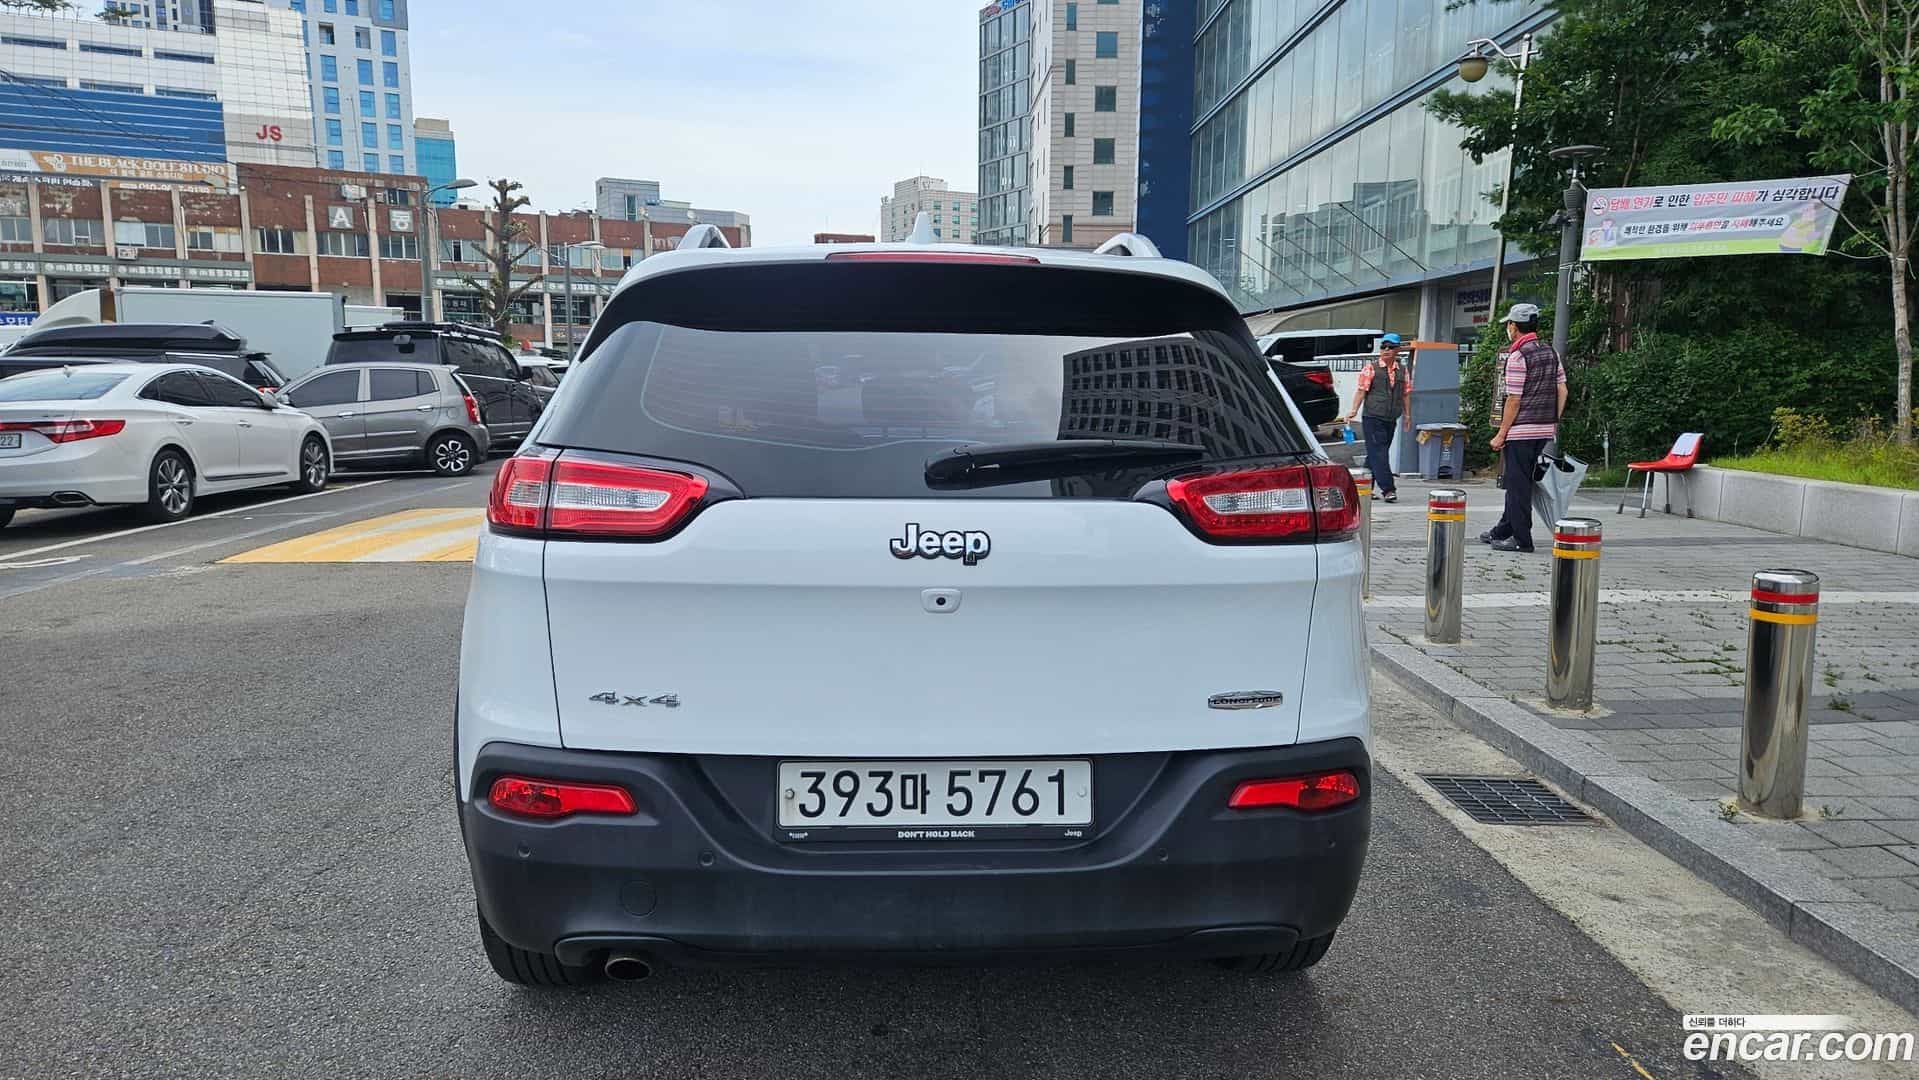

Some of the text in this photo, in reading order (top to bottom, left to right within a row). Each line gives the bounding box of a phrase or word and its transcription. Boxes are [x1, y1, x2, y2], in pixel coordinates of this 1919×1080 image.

[256, 125, 283, 141] JS
[1668, 194, 1690, 208] 인한
[1693, 191, 1729, 207] 입주민
[1733, 189, 1768, 205] 피해가
[1772, 185, 1840, 201] 심각합니다
[332, 208, 350, 228] A
[889, 522, 991, 566] Jeep
[798, 768, 1065, 818] 393마 5761
[897, 830, 924, 839] DON'T
[925, 830, 950, 839] HOLD
[950, 830, 976, 838] BACK
